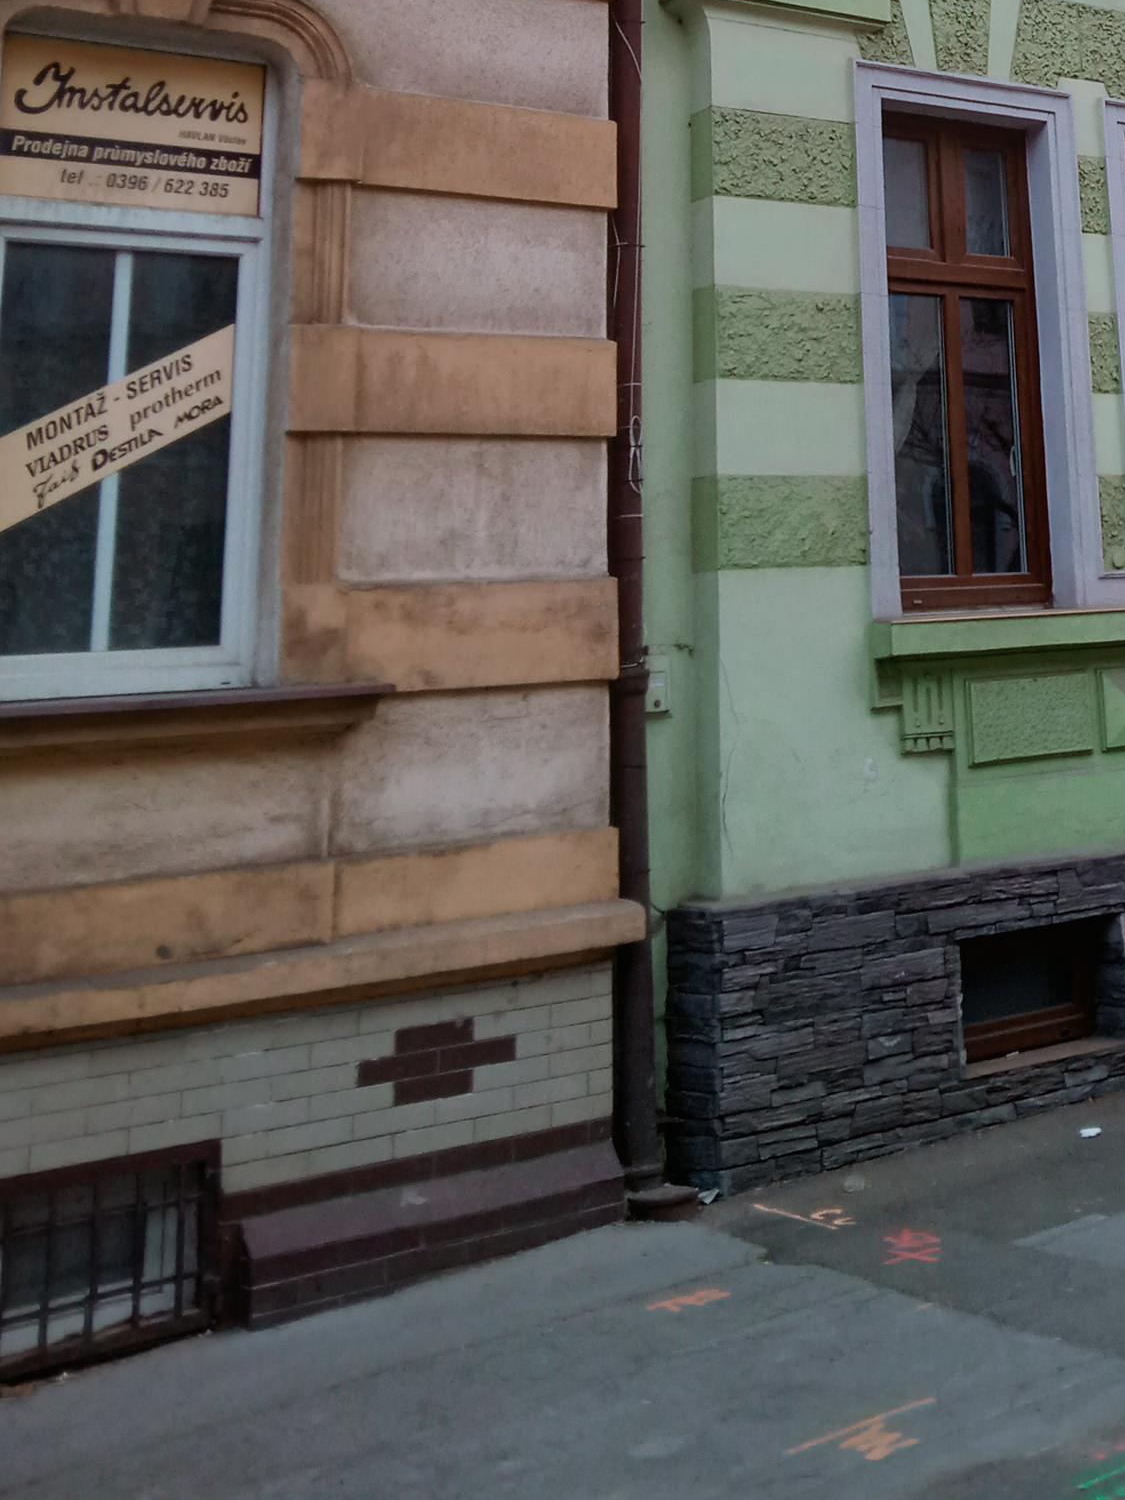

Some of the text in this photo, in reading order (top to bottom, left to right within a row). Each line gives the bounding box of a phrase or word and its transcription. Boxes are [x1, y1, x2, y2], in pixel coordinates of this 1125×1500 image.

[14, 62, 248, 124] Instalservis
[11, 136, 251, 174] Prodejna průmyslového zboží
[106, 173, 148, 191] 0396
[164, 177, 193, 195] 622
[199, 181, 229, 198] 385
[125, 354, 194, 400] SERVIS
[25, 368, 222, 478] VIADRUS protherm
[173, 395, 224, 429] MORA
